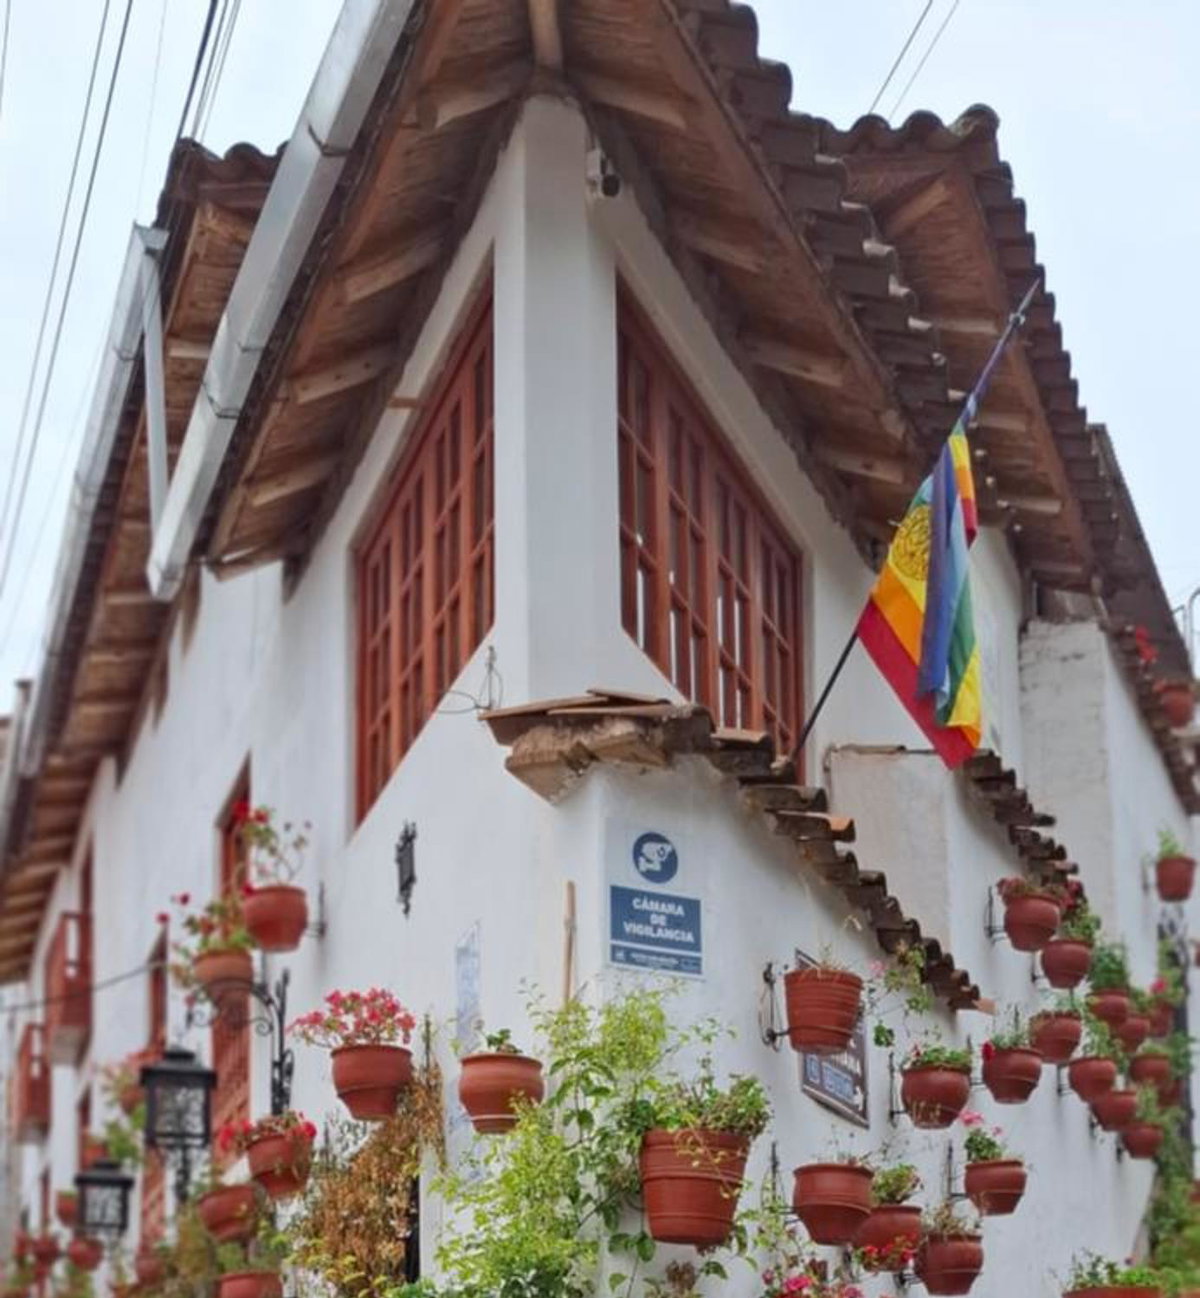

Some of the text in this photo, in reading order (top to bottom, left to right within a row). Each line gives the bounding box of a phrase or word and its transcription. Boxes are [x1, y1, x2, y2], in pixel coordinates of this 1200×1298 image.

[632, 896, 685, 916] CÁMARA
[650, 914, 666, 927] DE
[623, 921, 695, 943] VIGILANCIA
